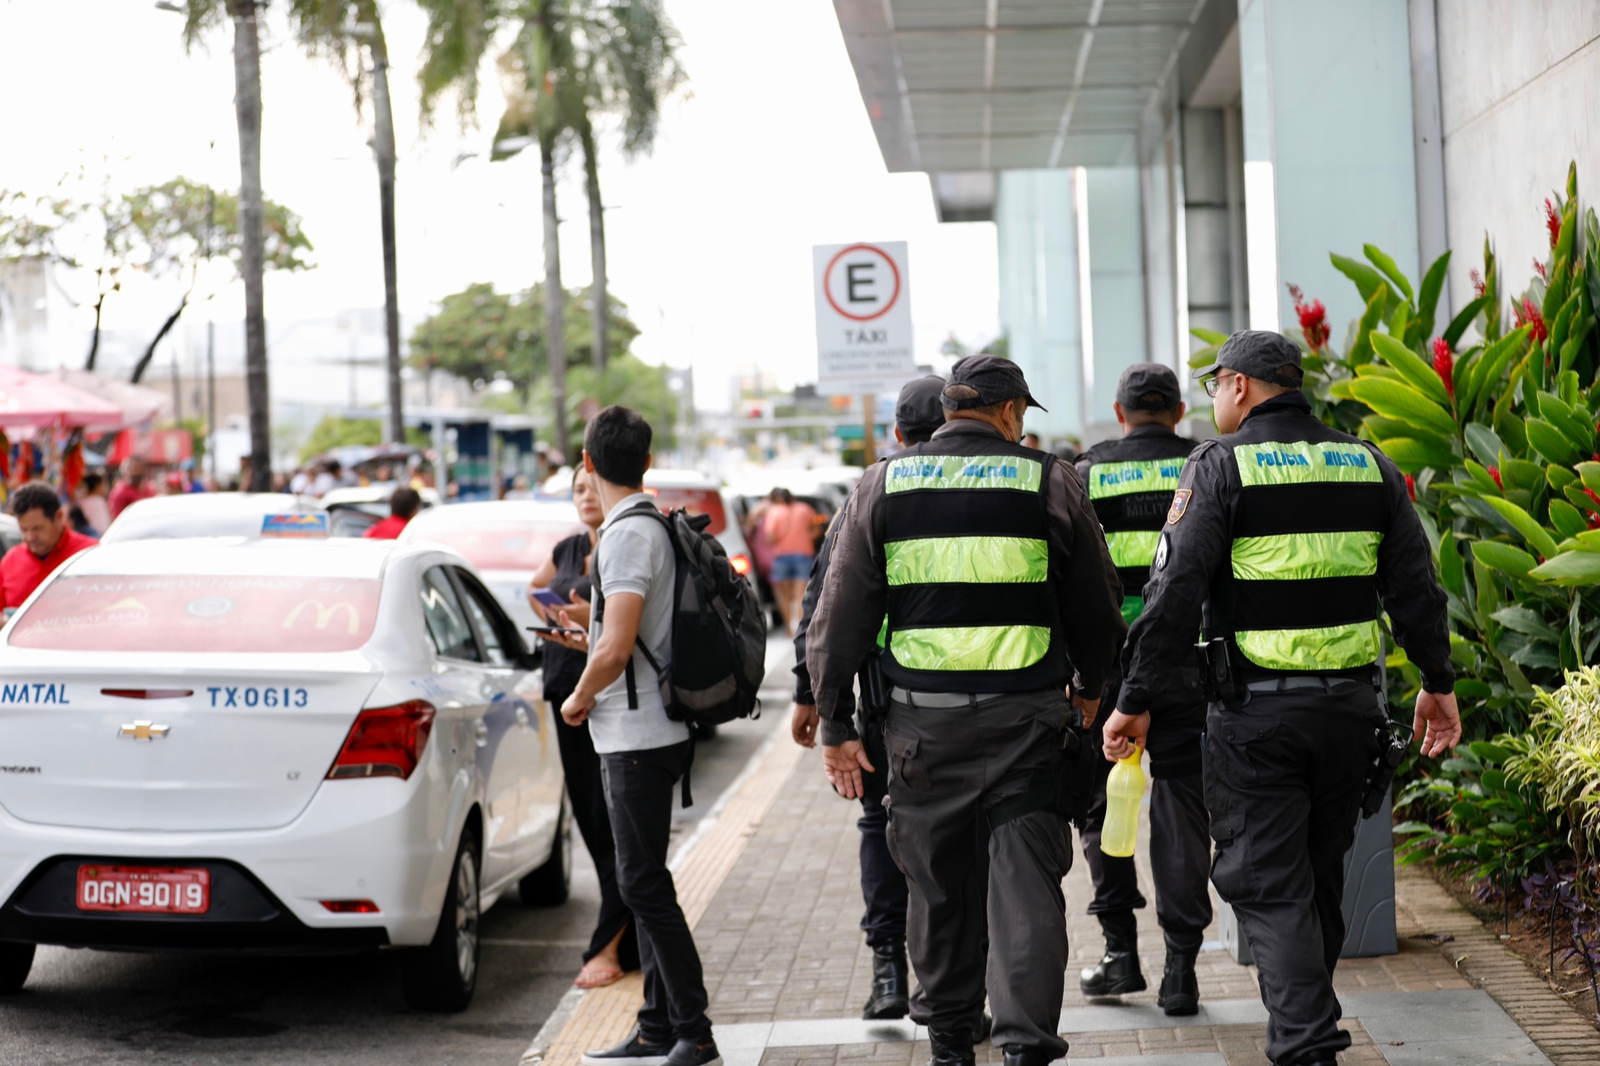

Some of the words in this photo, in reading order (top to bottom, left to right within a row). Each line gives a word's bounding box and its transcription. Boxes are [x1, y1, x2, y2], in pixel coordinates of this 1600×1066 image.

[846, 263, 878, 303] E
[1255, 448, 1310, 467] POLÍCIA
[1322, 451, 1368, 468] MILITAR
[893, 462, 943, 479] POLÍCIA
[963, 464, 1017, 479] MILITAR
[1099, 467, 1144, 487] POLÍCIA
[1126, 502, 1170, 518] MILIT
[1, 684, 70, 705] NATAL
